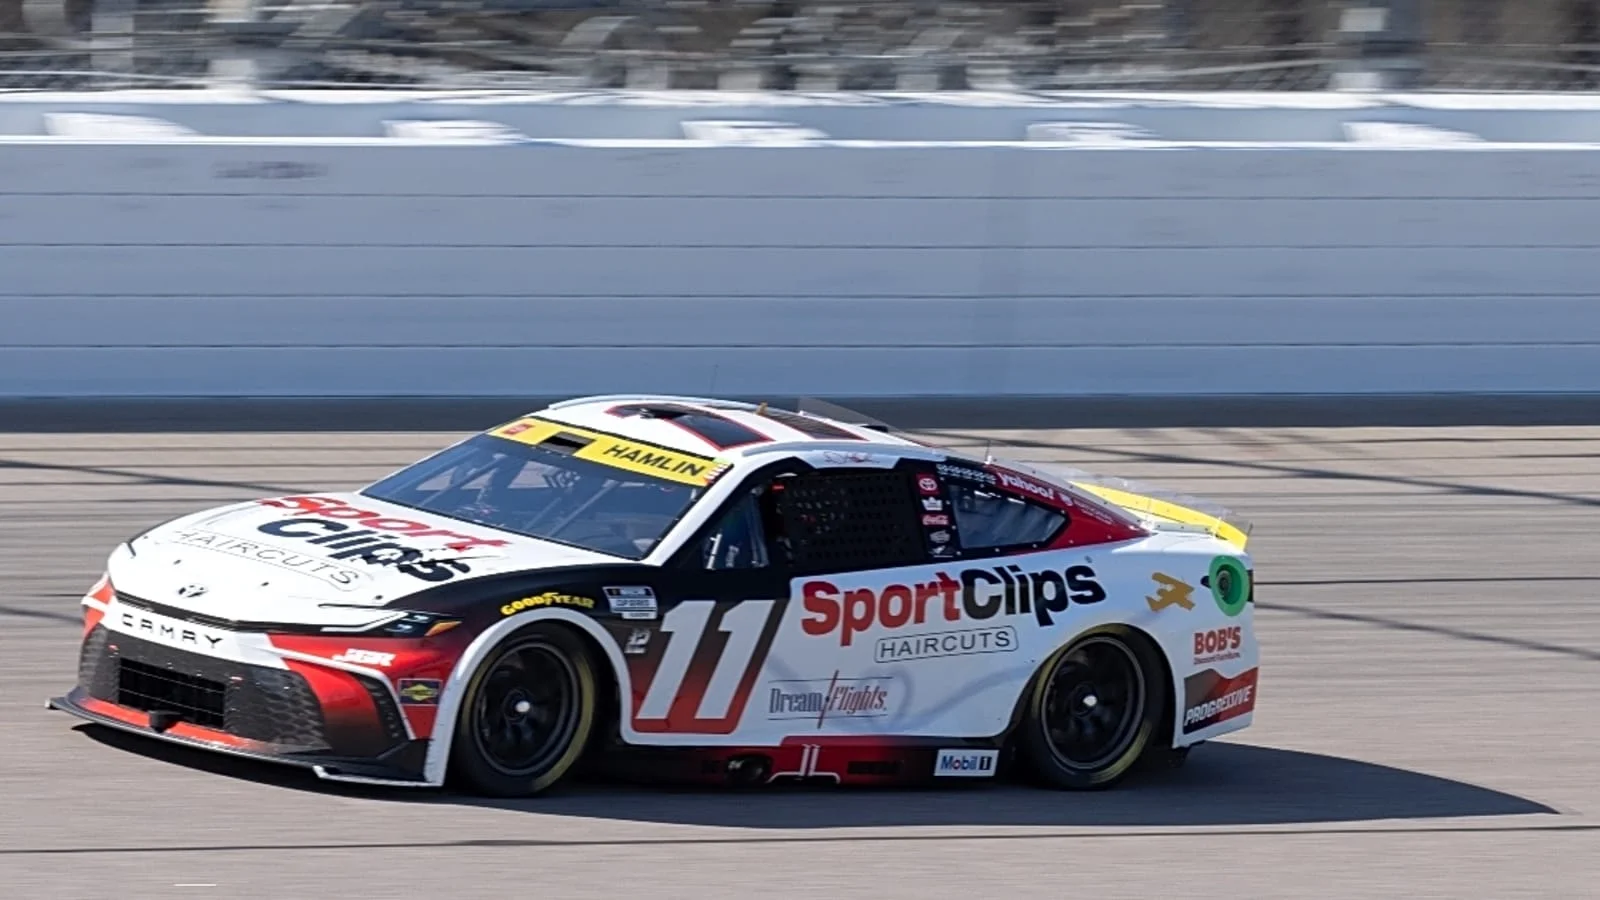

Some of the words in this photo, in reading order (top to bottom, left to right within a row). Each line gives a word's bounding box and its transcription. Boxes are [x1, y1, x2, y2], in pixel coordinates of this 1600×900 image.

[603, 445, 706, 477] HAMLIN
[256, 497, 508, 551] Sport
[174, 531, 359, 584] HAIRCUTS
[257, 518, 472, 582] Clips
[500, 592, 595, 616] GOODYEAR
[122, 612, 224, 649] CAMRY
[880, 630, 1011, 659] HAIRCUTS
[1194, 627, 1241, 655] BOB'S
[635, 600, 776, 720] 11
[769, 688, 822, 713] Dream
[940, 756, 978, 771] Mobil
[979, 756, 992, 771] 1
